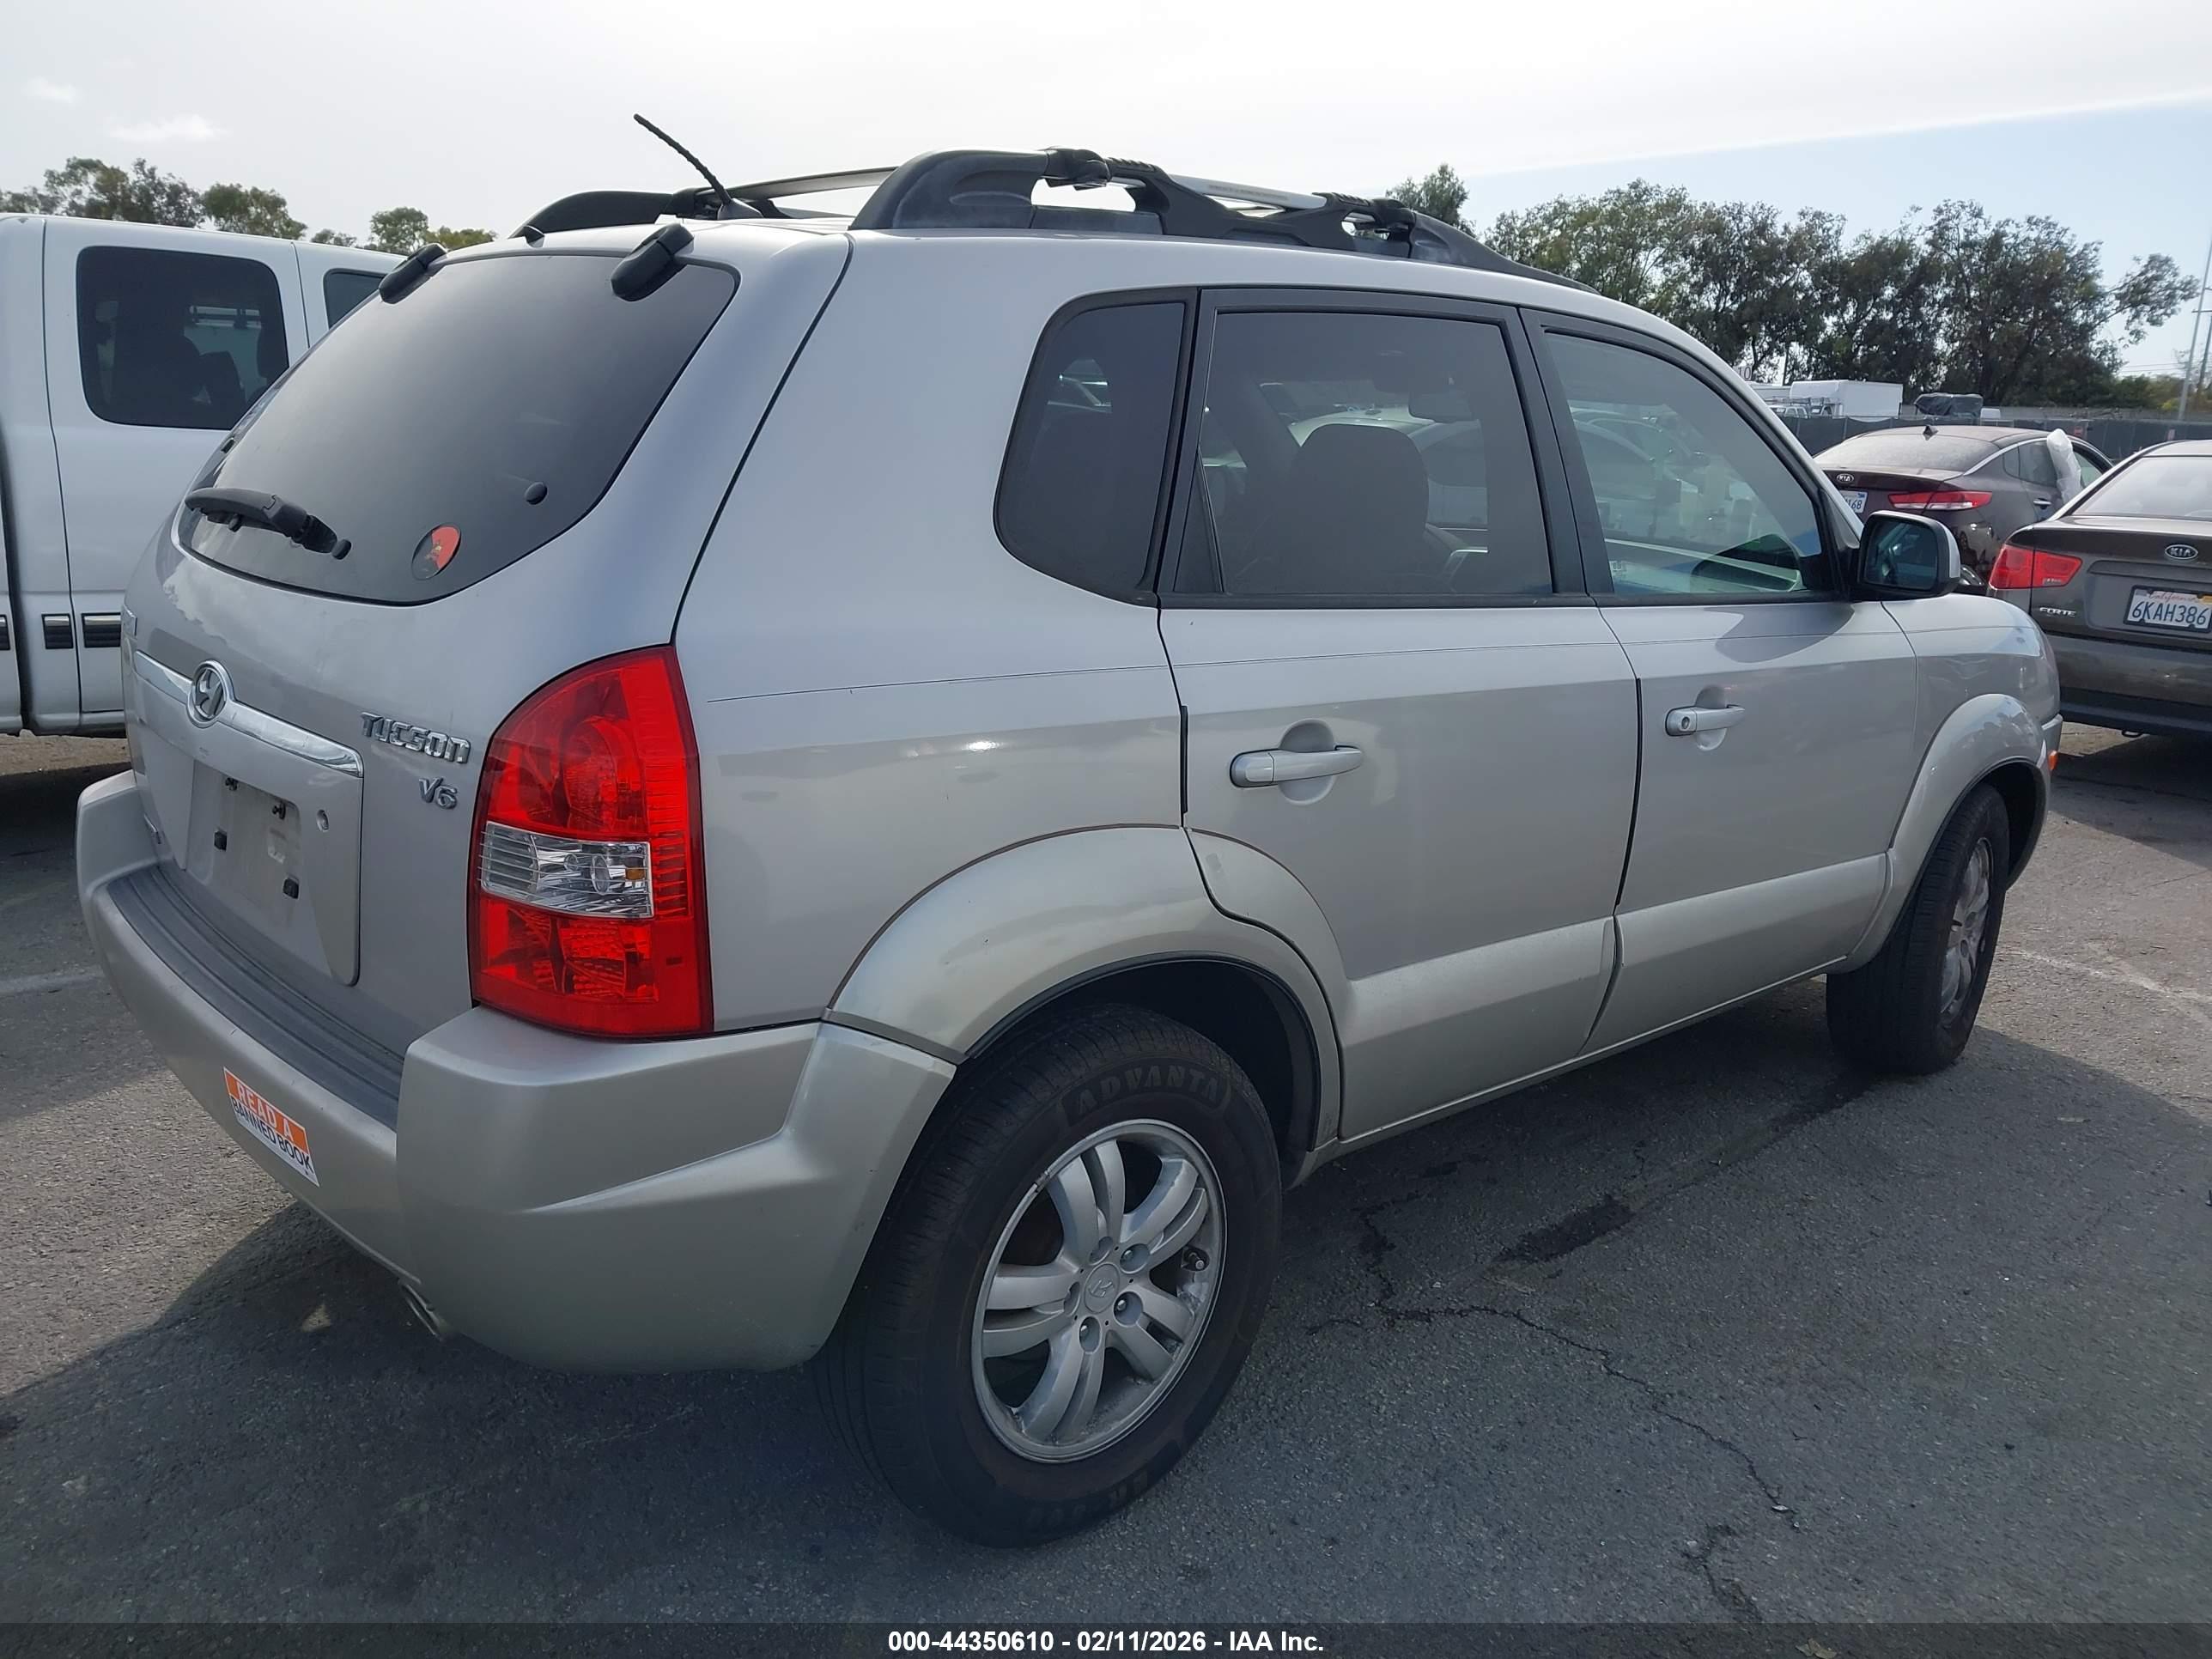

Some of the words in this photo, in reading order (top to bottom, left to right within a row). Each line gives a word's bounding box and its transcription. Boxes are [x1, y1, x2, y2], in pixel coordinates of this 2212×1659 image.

[2169, 547, 2191, 557] KIA
[2131, 601, 2209, 626] 6KAH386
[360, 711, 471, 763] TUCSON
[418, 777, 459, 810] V6
[236, 1080, 277, 1128] READ
[283, 1119, 295, 1143] A
[1078, 1064, 1220, 1115] ADVANTA
[231, 1097, 276, 1145] BANNED
[276, 1134, 314, 1175] BOOK
